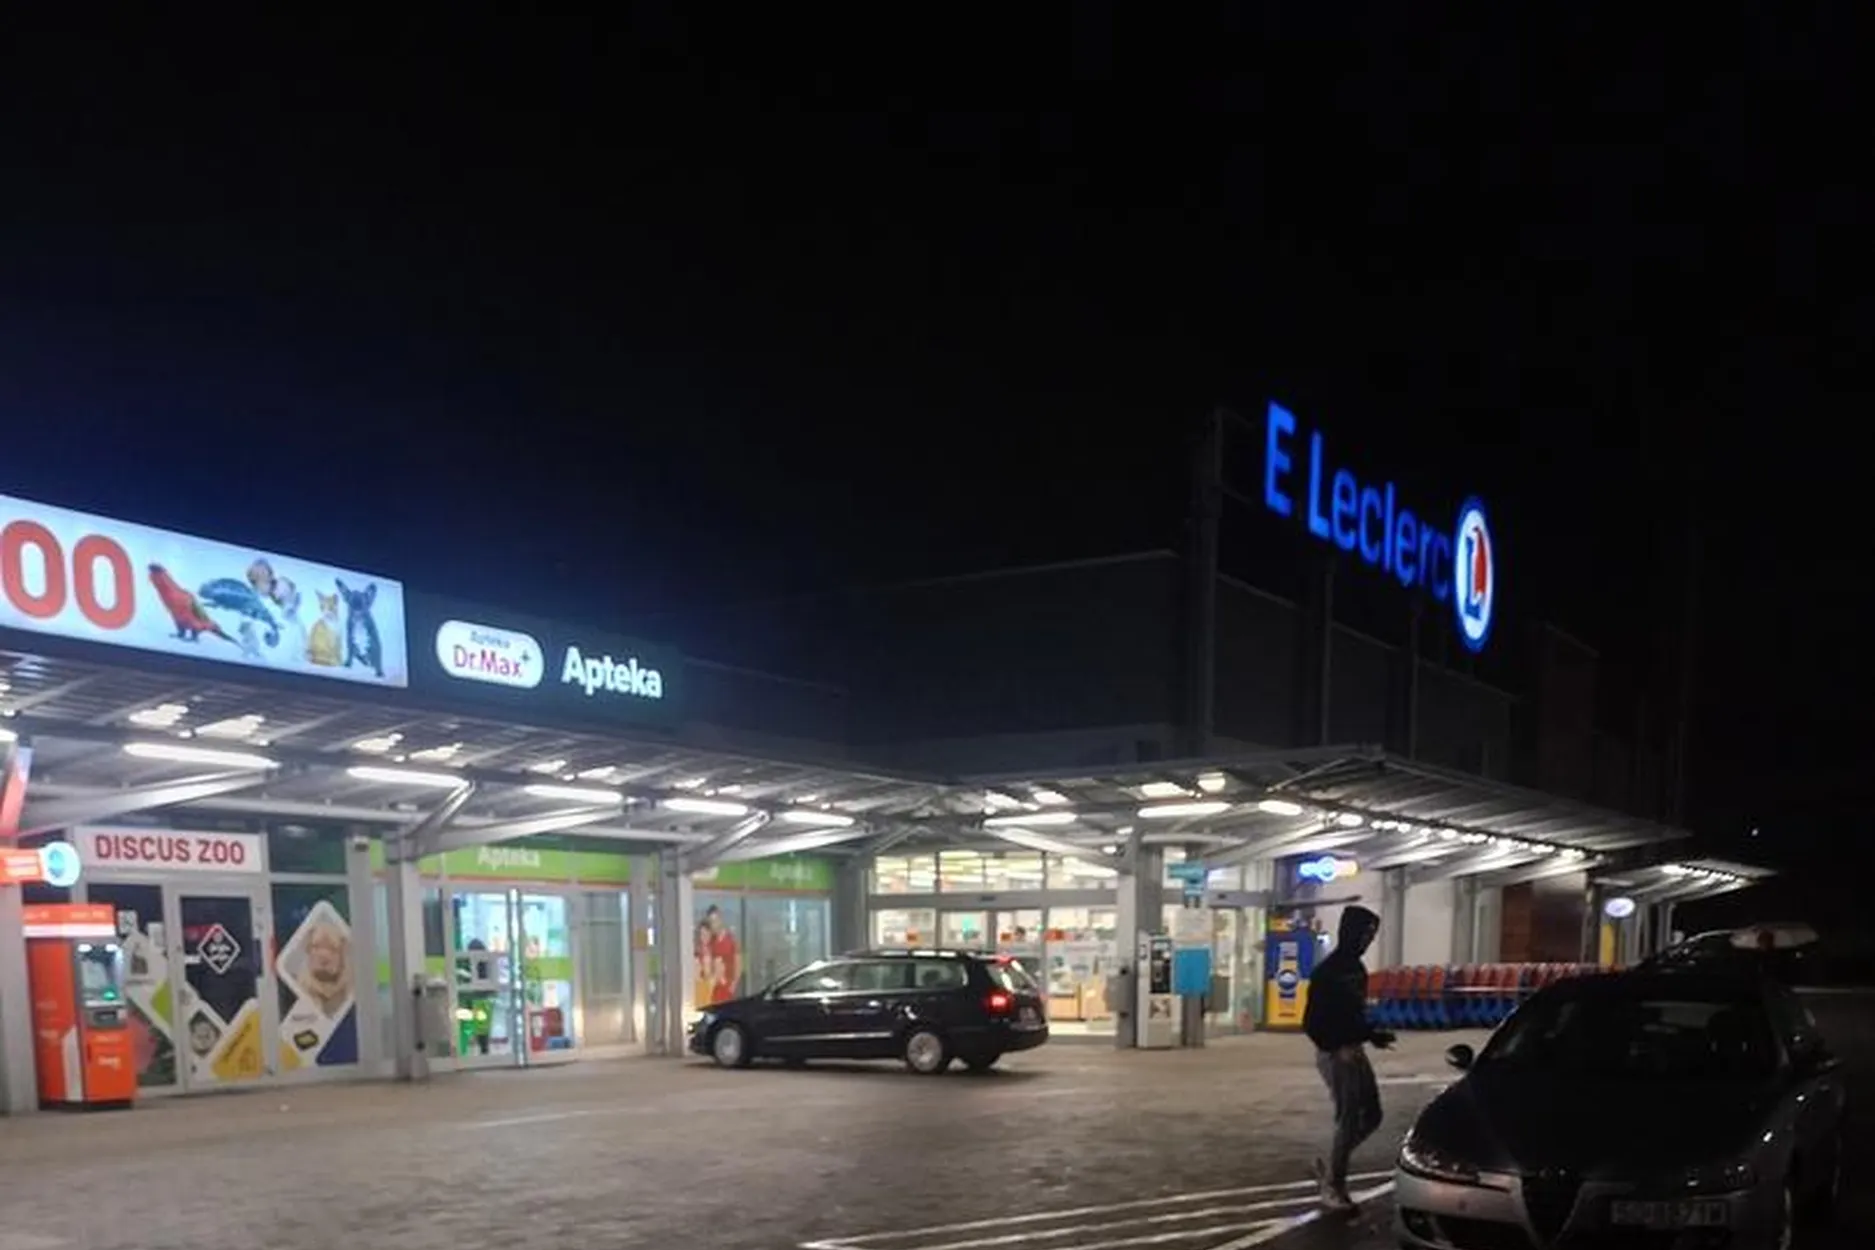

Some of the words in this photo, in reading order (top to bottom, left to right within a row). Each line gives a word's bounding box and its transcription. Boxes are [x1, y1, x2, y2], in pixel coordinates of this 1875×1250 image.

[1265, 400, 1296, 518] E
[1307, 429, 1451, 601] Leclerc
[561, 646, 663, 698] Apteka
[94, 835, 191, 863] DISCUS
[198, 839, 245, 865] ZOO
[477, 846, 541, 870] Apteka
